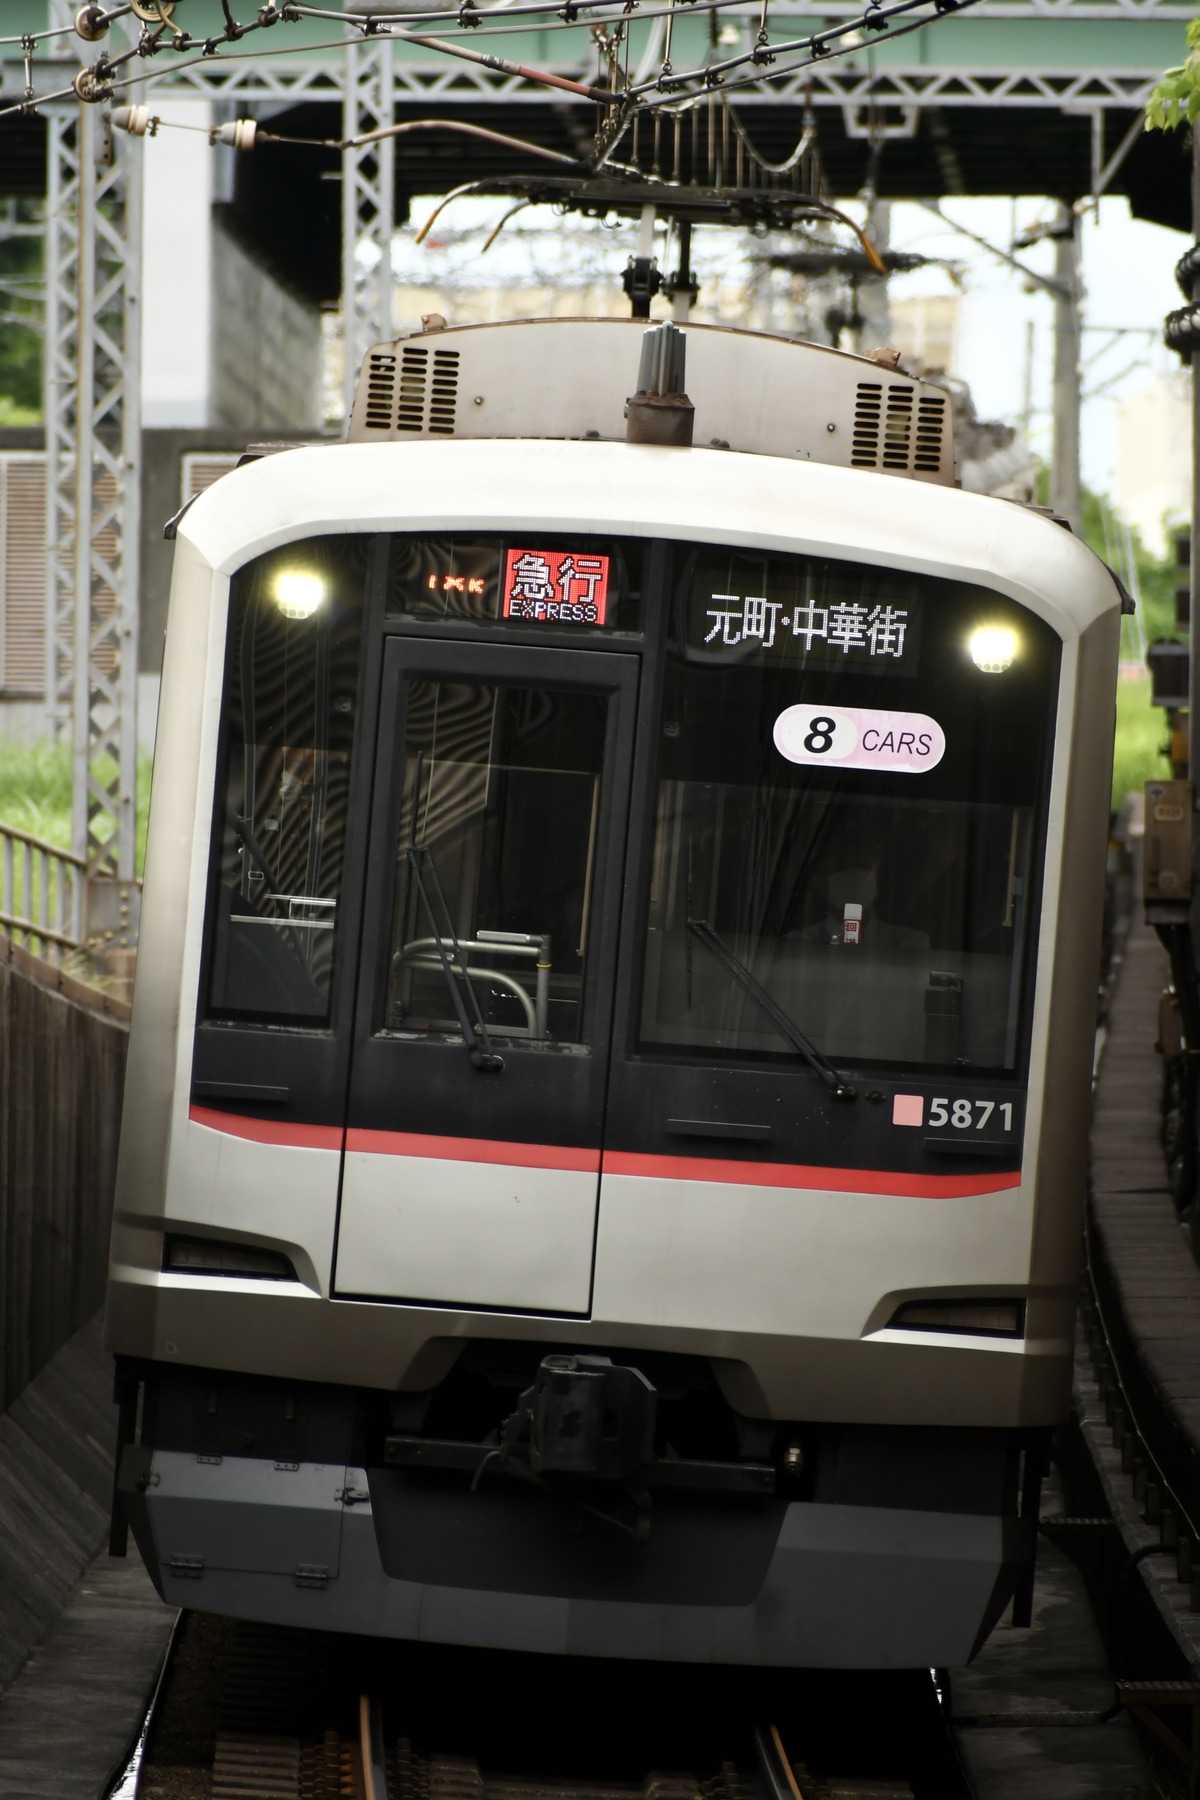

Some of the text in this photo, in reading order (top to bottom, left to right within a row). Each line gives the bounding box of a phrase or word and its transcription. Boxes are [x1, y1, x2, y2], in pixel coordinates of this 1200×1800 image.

[511, 553, 602, 602] 急行
[509, 600, 597, 622] EXPRESS
[803, 716, 933, 756] 8 CARS
[928, 1097, 1013, 1131] 5871
